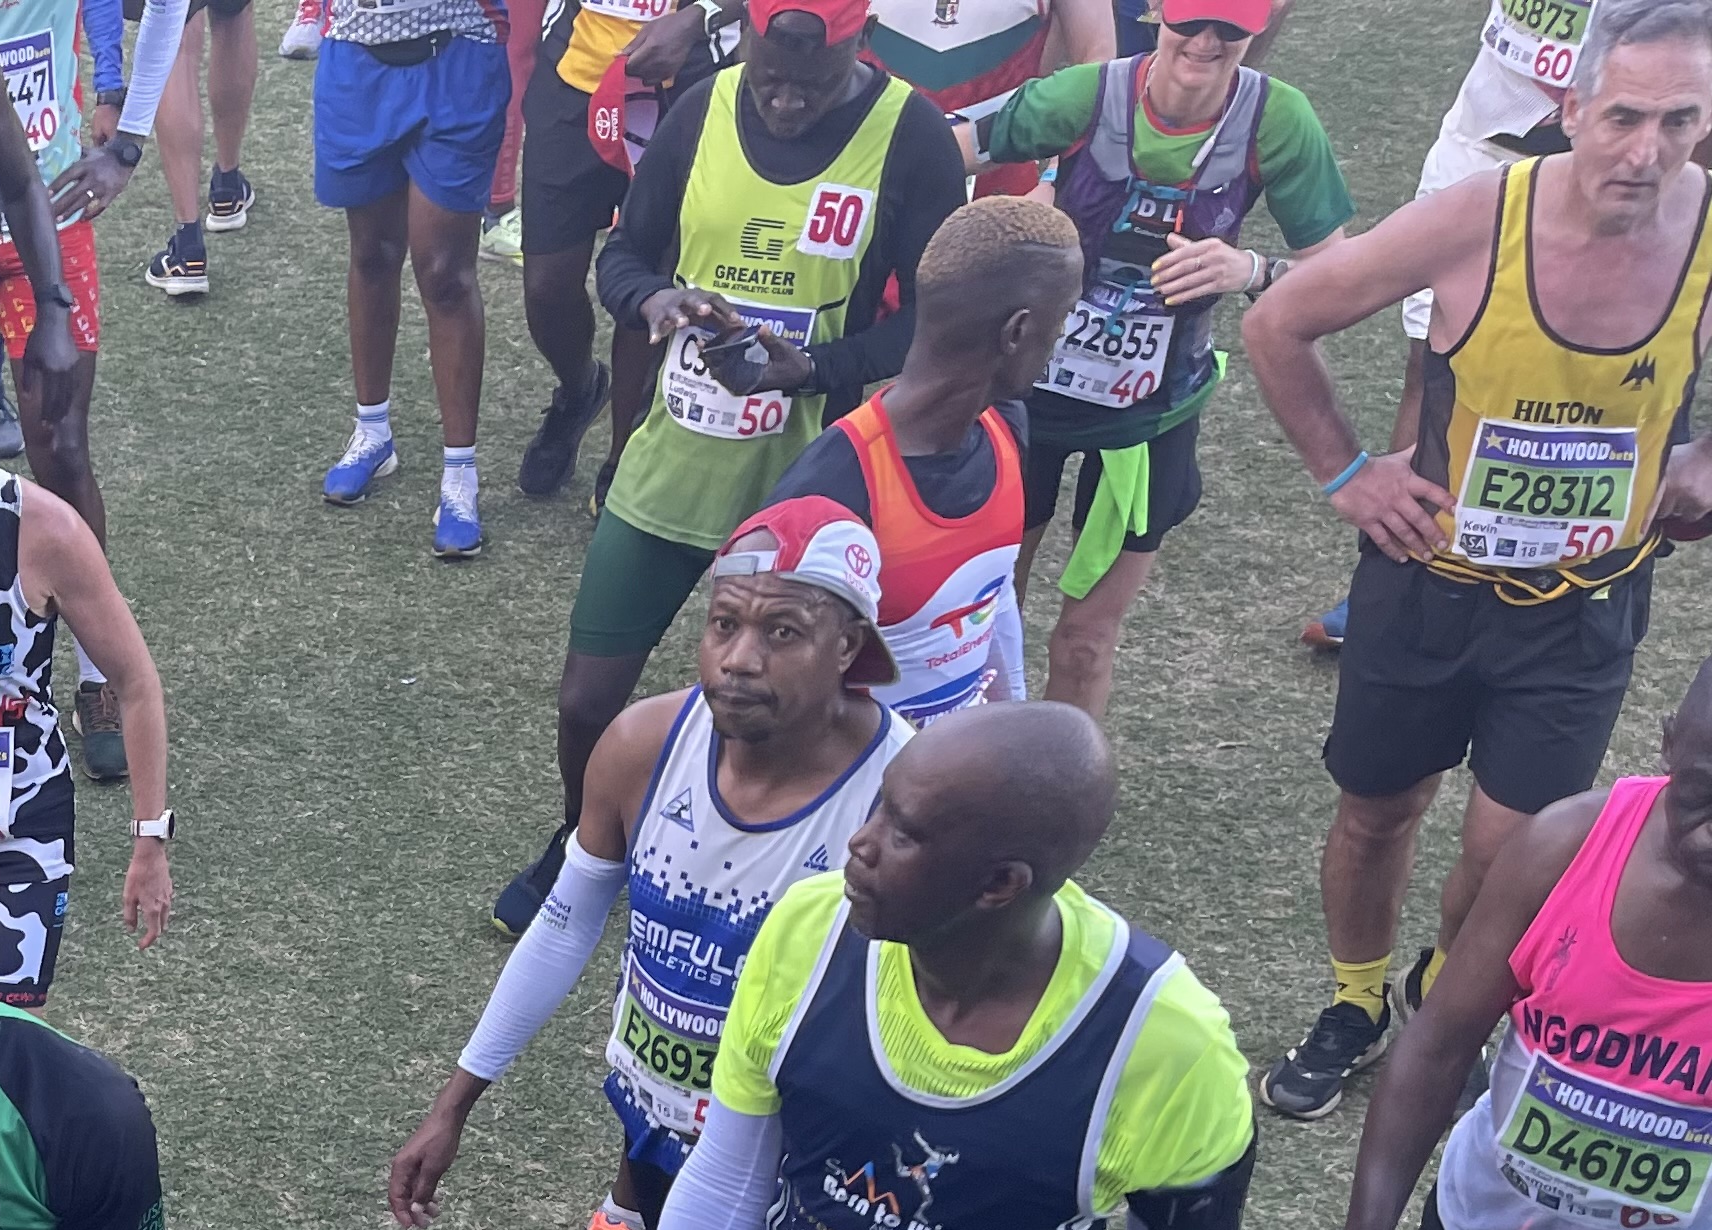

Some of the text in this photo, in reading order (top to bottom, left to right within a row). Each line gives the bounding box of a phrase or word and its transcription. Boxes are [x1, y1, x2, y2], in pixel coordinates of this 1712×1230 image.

[1534, 44, 1573, 81] 60
[25, 107, 57, 145] 40
[808, 190, 865, 248] 50
[714, 264, 796, 287] GREATER
[730, 282, 769, 294] ATHLETIC
[771, 287, 794, 296] CLUB
[1108, 369, 1156, 404] 40
[737, 397, 783, 436] 50
[1511, 398, 1605, 426] HILTON
[1479, 466, 1616, 517] E28312
[1463, 519, 1498, 535] Kevin
[1559, 524, 1615, 562] 50
[1520, 545, 1537, 558] 18
[629, 934, 723, 987] ATHLETICS
[623, 1003, 716, 1089] E2693
[1512, 1106, 1692, 1203] D46199
[823, 1174, 871, 1217] Born
[873, 1203, 902, 1229] to
